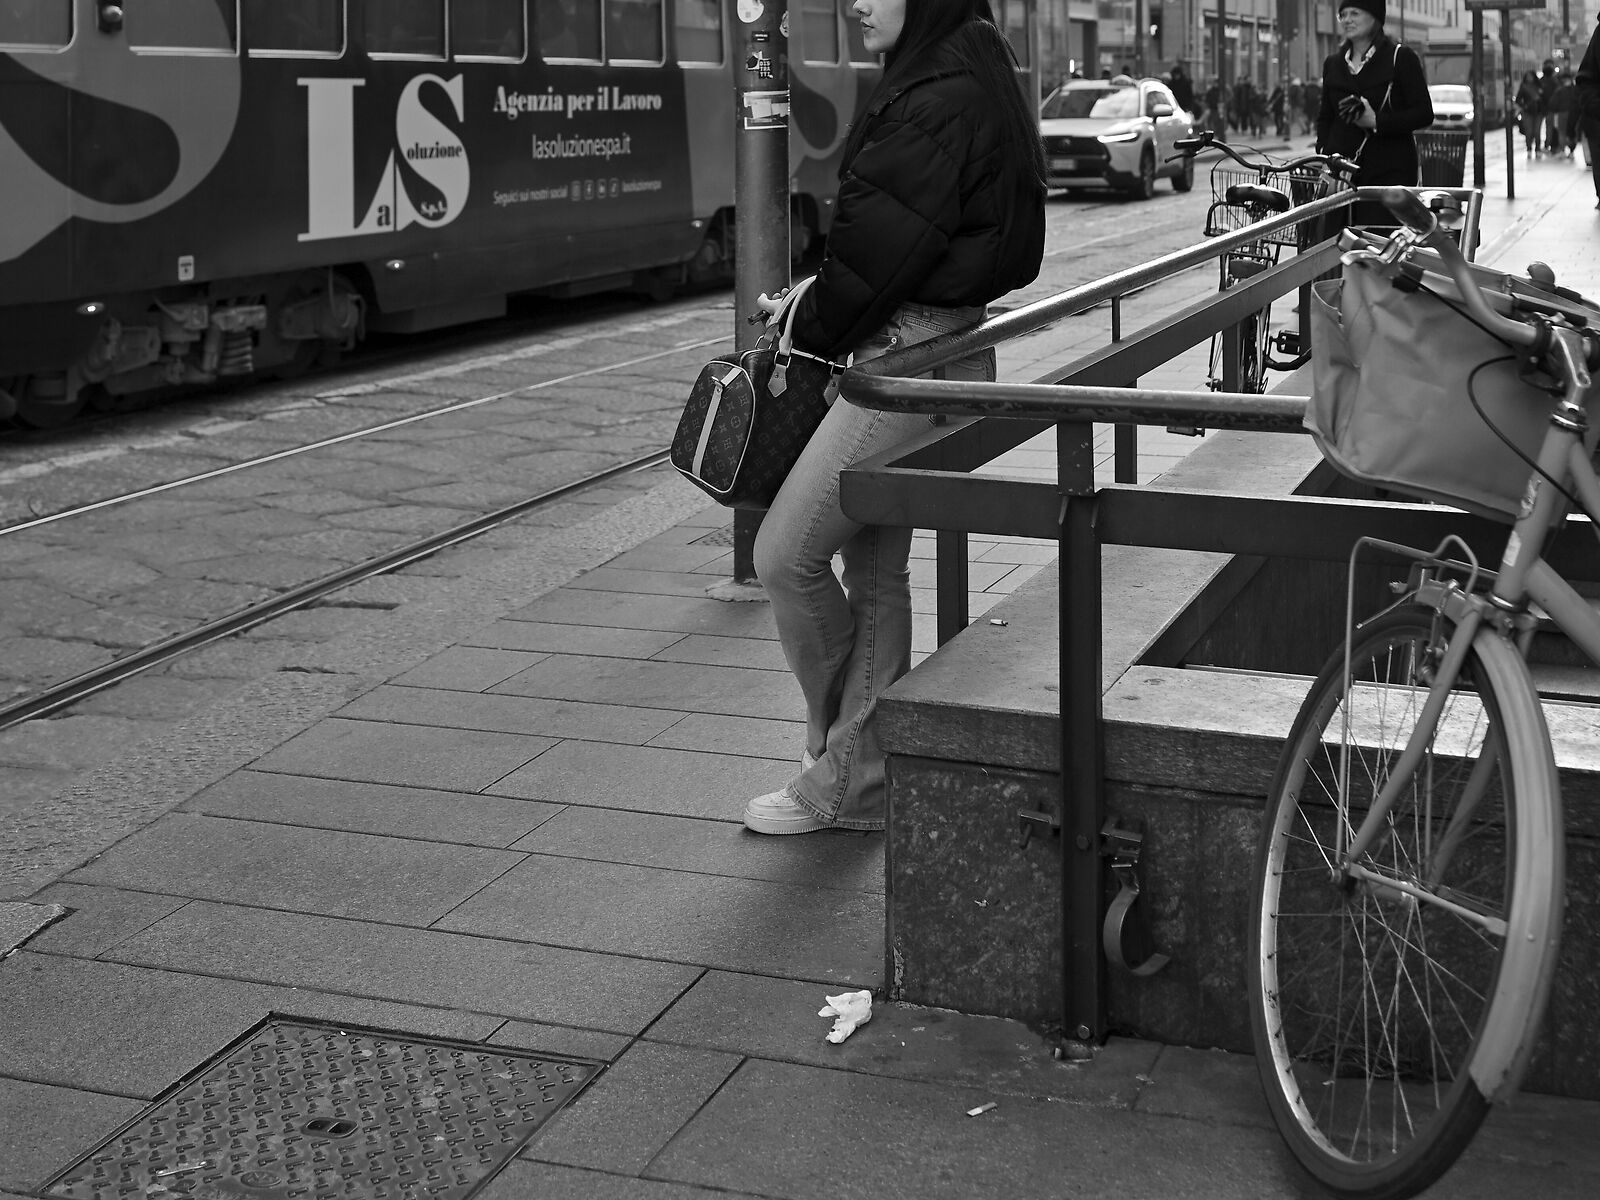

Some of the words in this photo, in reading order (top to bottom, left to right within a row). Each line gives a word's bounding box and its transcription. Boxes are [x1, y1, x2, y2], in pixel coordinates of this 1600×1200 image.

[493, 85, 563, 120] Agenzia
[567, 94, 594, 118] per
[598, 86, 609, 110] il
[613, 86, 662, 110] Lavoro
[532, 133, 631, 161] lasoluzionespa.it
